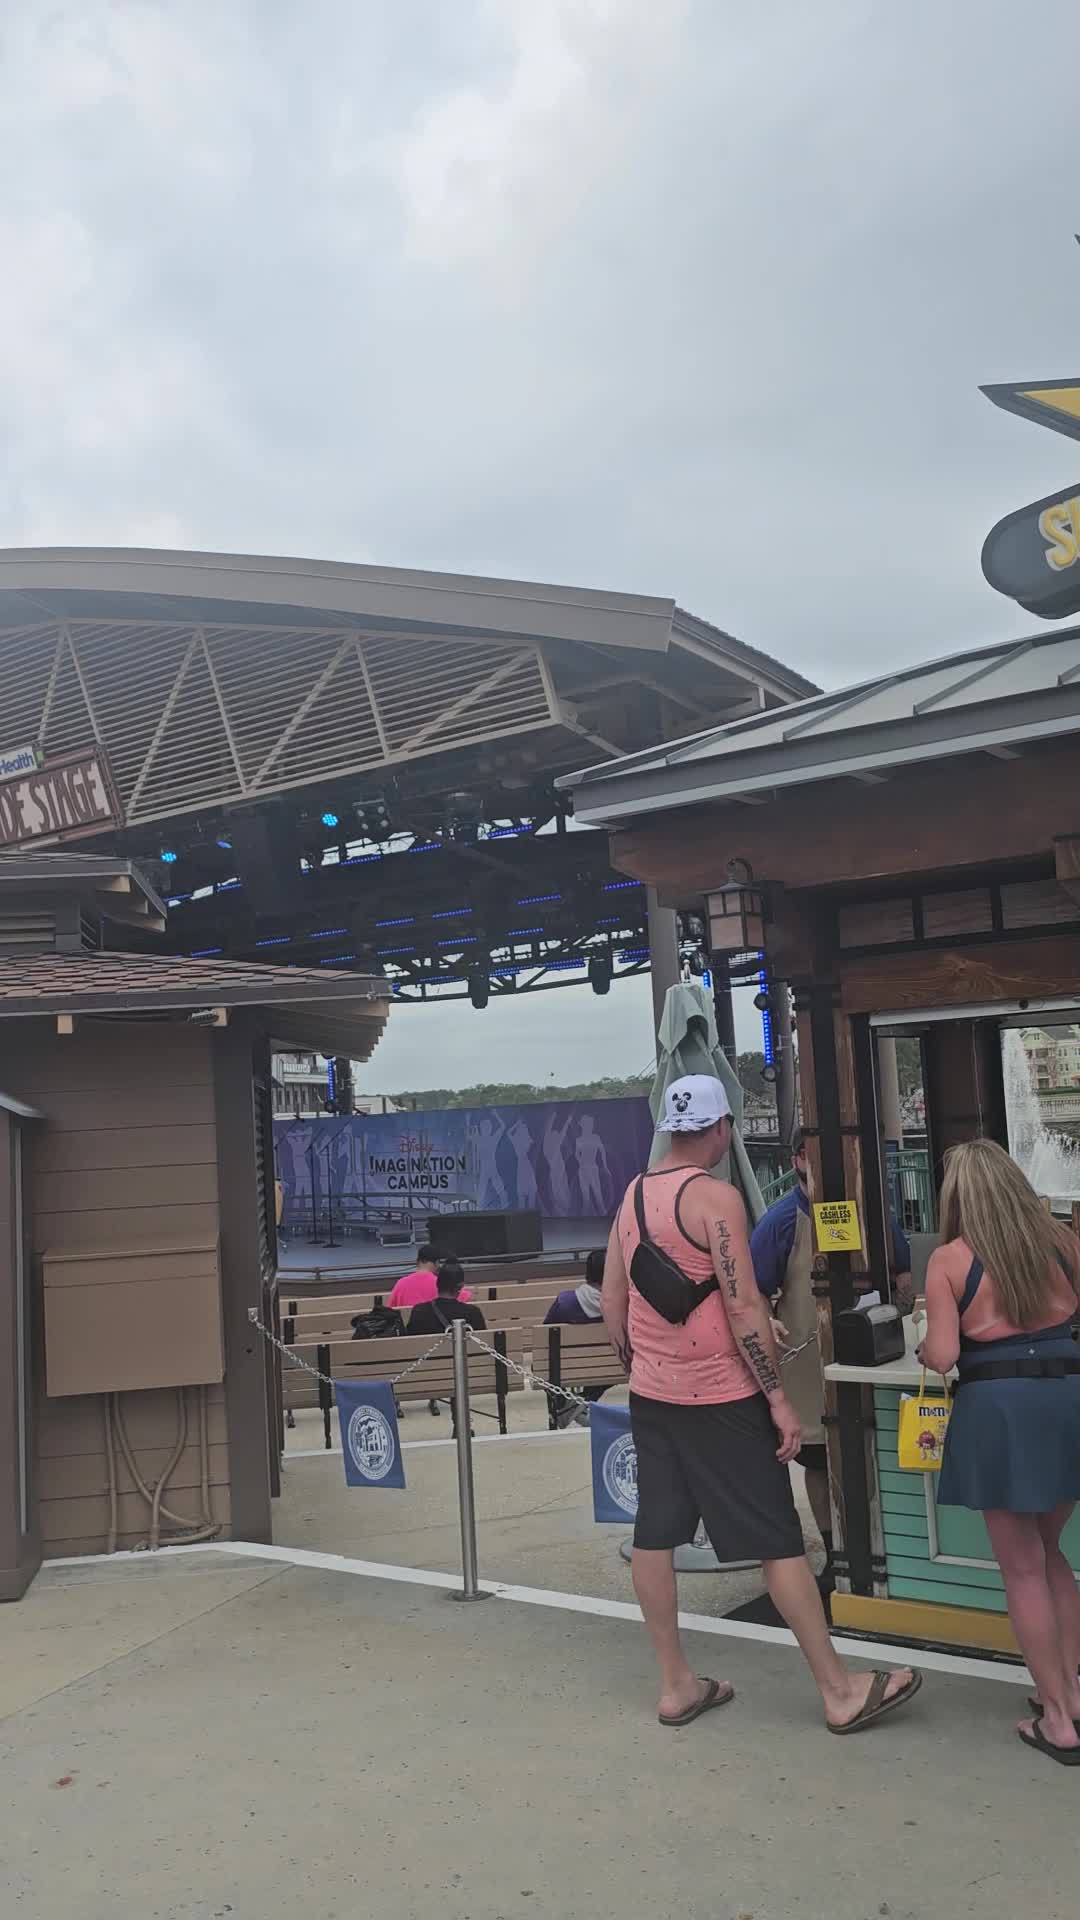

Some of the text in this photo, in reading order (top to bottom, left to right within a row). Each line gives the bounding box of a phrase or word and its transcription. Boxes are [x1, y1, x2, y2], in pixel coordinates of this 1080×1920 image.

[29, 762, 106, 832] STAGE
[387, 1174, 449, 1189] CAMPUS
[820, 1210, 851, 1220] CASHLESS
